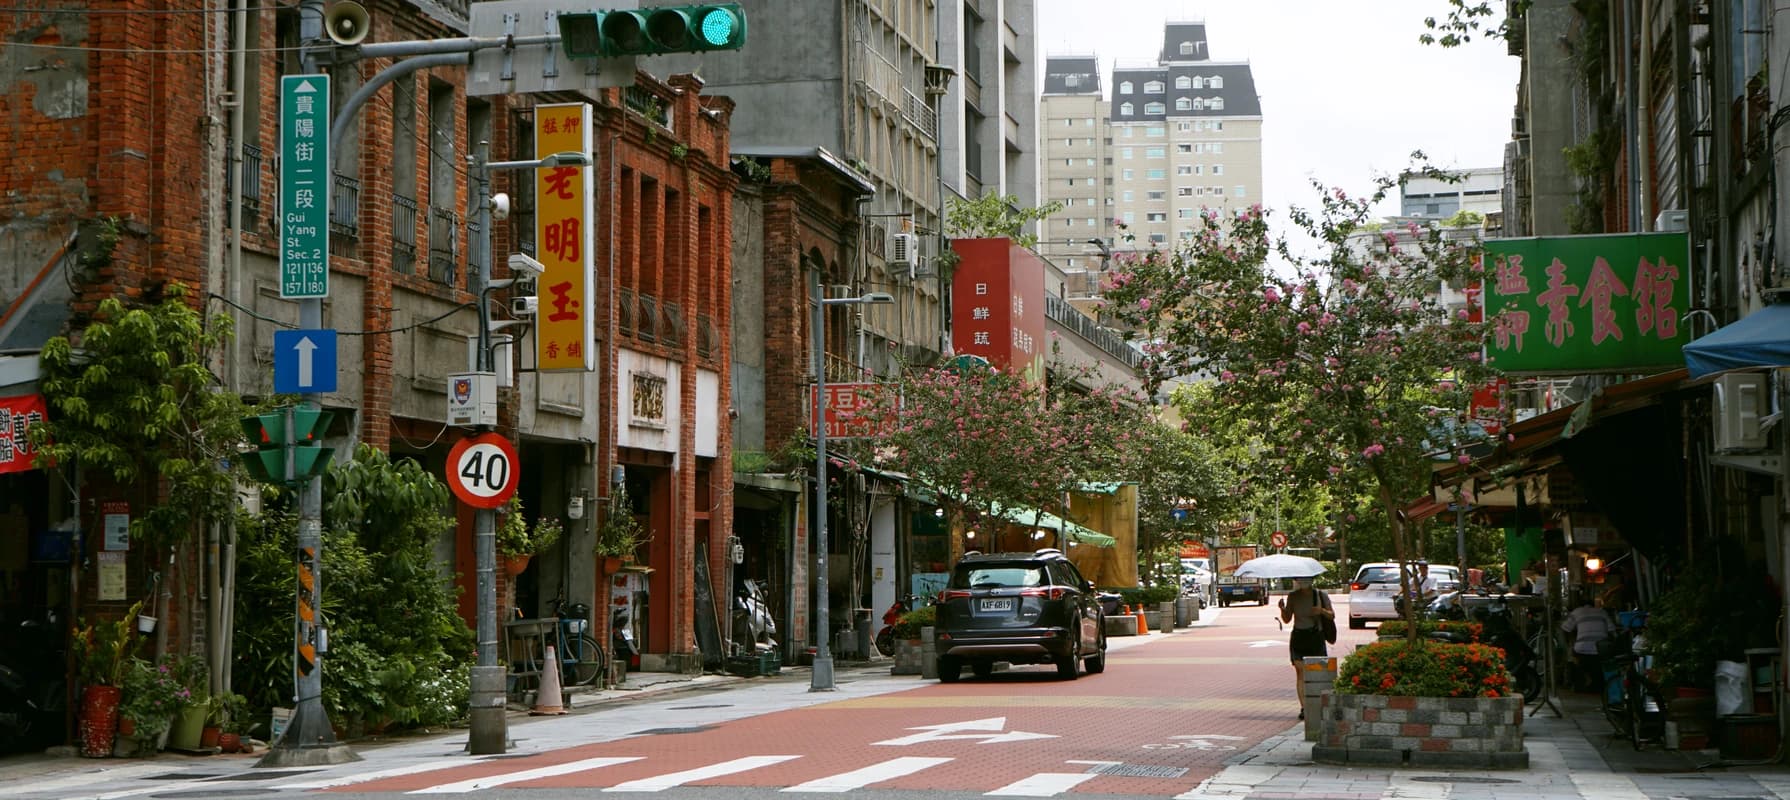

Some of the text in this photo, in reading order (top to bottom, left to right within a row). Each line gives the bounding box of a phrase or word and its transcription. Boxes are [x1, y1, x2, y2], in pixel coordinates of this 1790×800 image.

[543, 115, 580, 135] 艋舺
[295, 95, 314, 208] 貴陽街二段
[286, 212, 305, 223] Gui
[286, 225, 316, 237] Yang
[543, 165, 580, 323] 老明玉
[286, 248, 321, 260] Sec. 2
[286, 263, 324, 274] 121 136
[286, 281, 324, 294] 157 180
[973, 282, 990, 345] 日鮮蔬
[461, 450, 508, 491] 40
